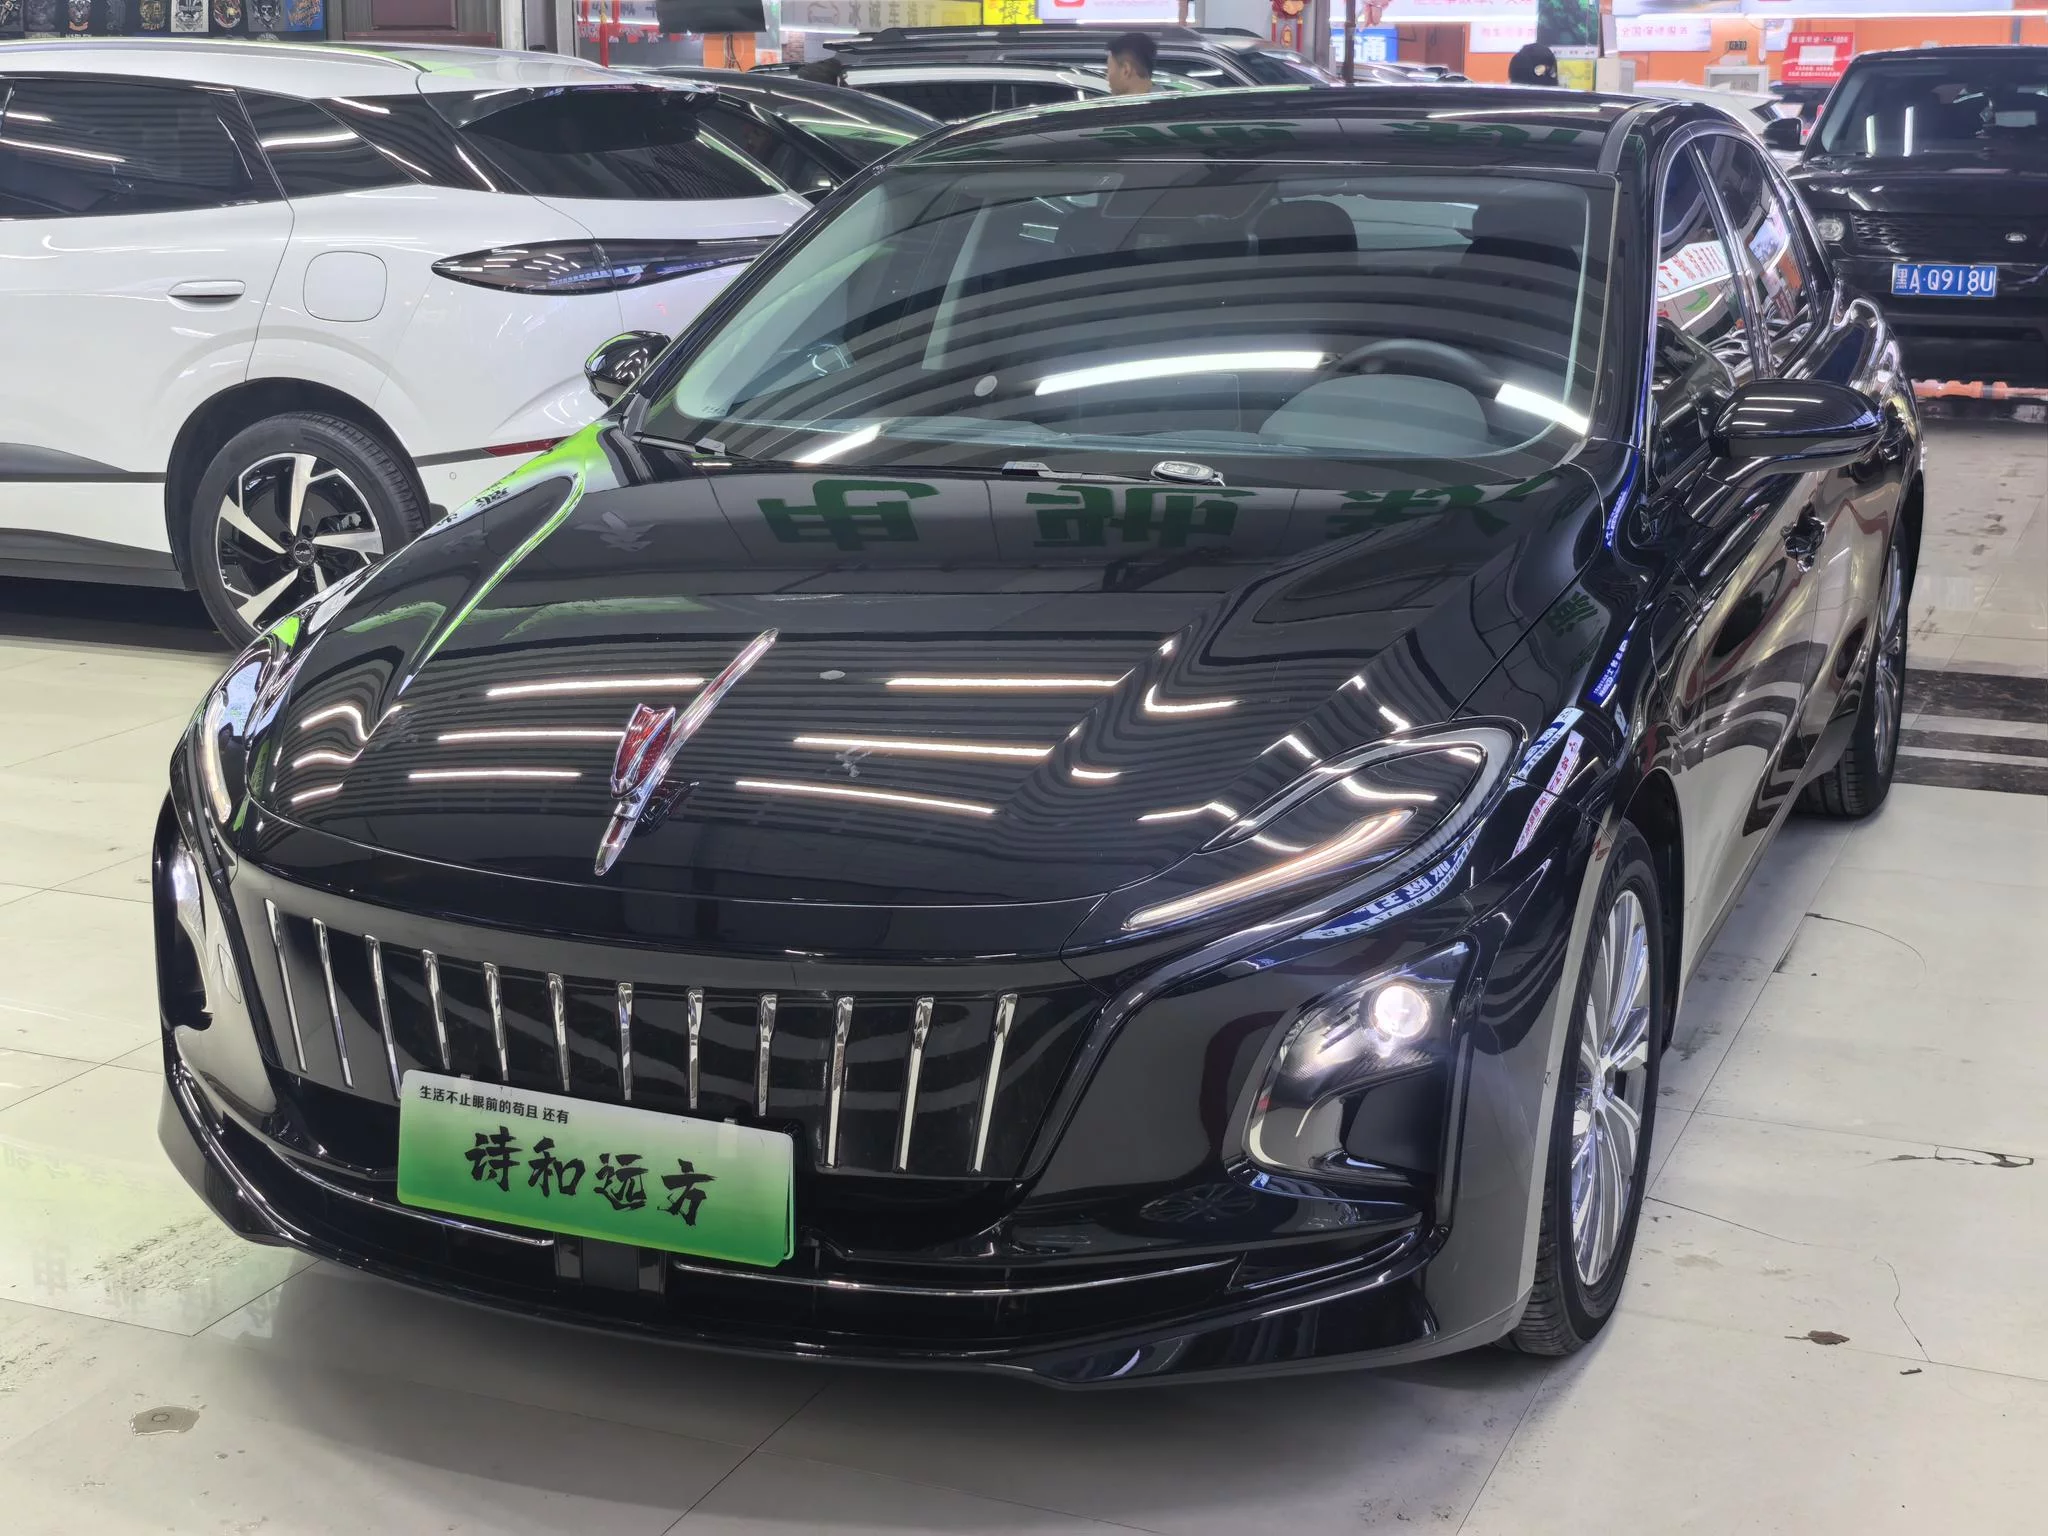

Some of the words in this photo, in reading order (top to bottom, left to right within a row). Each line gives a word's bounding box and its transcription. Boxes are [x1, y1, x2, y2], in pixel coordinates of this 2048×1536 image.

[419, 1085, 538, 1119] 生活不止眼前的苟且
[542, 1107, 570, 1124] 还有
[464, 1125, 718, 1227] 诗和远方
